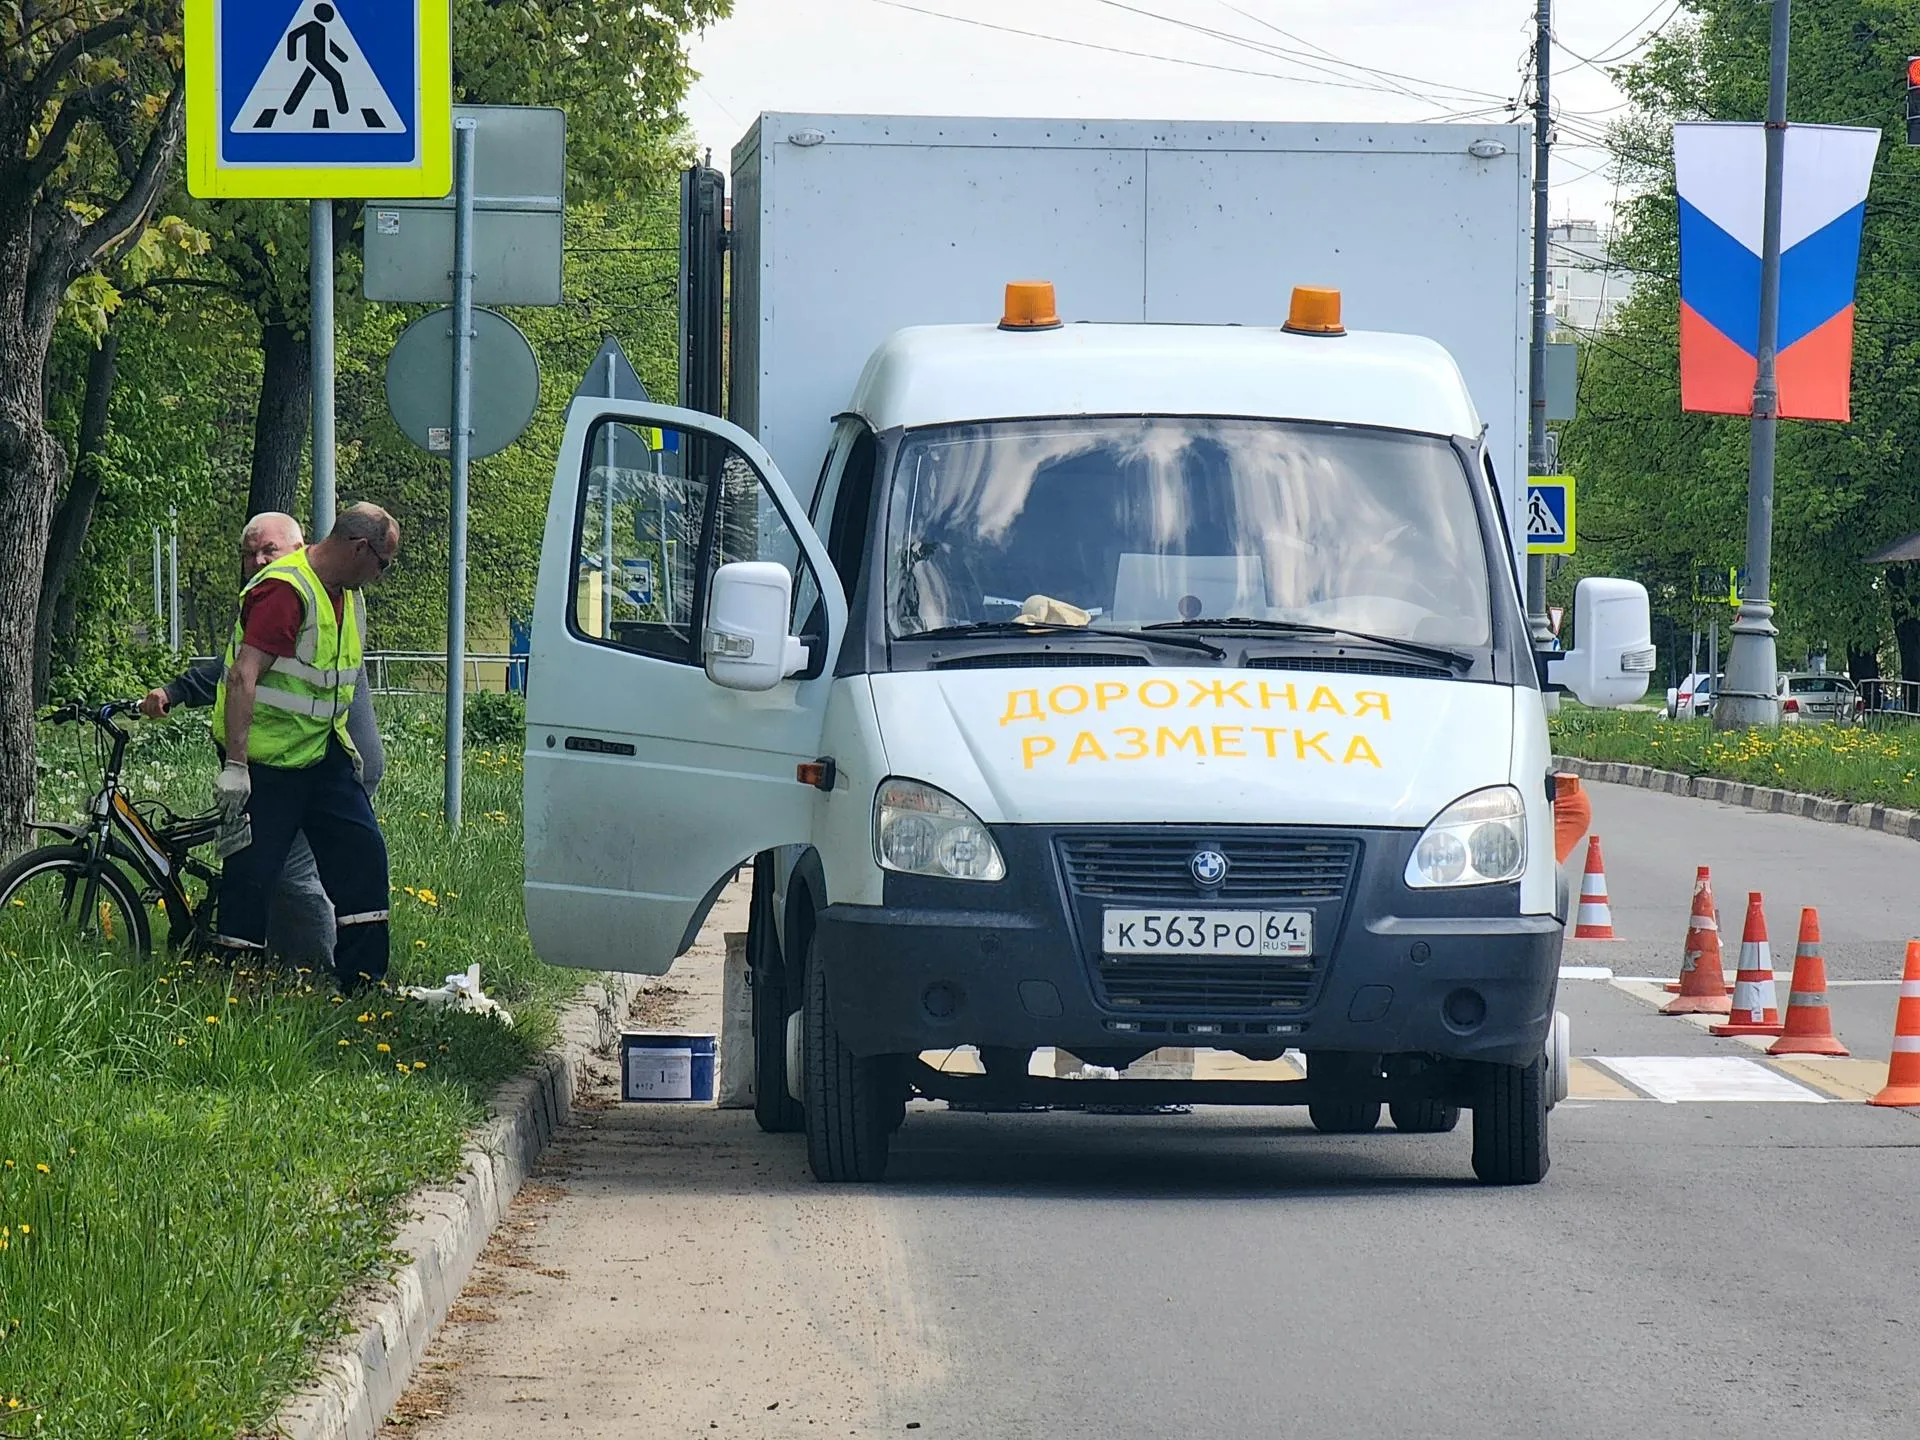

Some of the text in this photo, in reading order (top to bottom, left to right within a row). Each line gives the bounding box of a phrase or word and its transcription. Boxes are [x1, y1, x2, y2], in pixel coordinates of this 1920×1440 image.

[1000, 679, 1392, 727] ДОРОЖНАЯ
[1021, 724, 1382, 770] РАЗМЕТКА
[1263, 941, 1287, 950] RUS
[1265, 916, 1297, 940] 64
